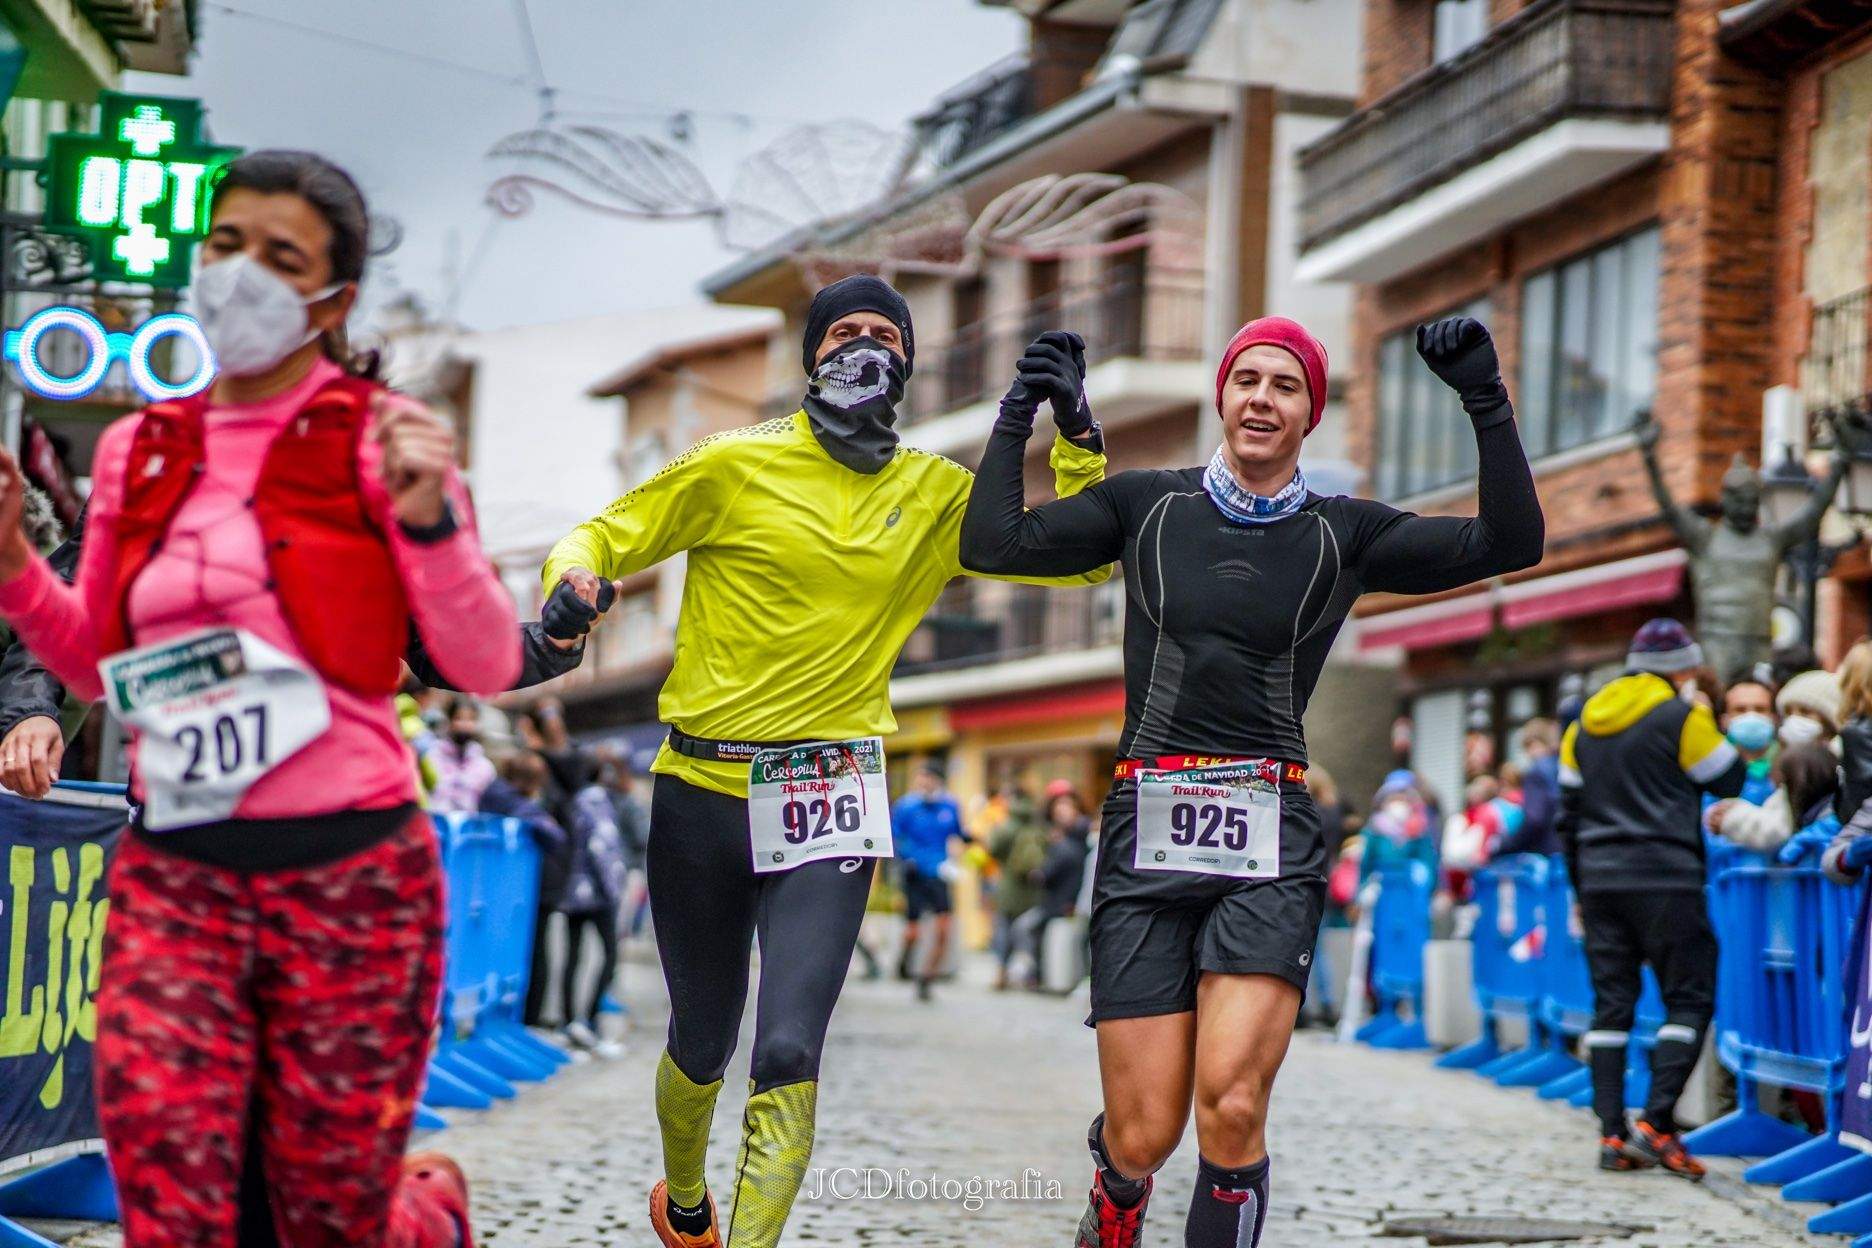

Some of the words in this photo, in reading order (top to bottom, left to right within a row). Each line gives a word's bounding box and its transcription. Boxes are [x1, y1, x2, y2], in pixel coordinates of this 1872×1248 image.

[76, 156, 213, 235] OPT
[174, 704, 266, 782] 207
[717, 742, 762, 754] triathlon
[854, 744, 873, 754] 2021
[1114, 764, 1128, 776] EKI
[1183, 757, 1231, 767] LEKI
[1287, 767, 1305, 780] LE
[1204, 769, 1248, 780] NAVIDAD
[780, 782, 807, 794] Trail
[808, 781, 836, 792] Run
[1171, 785, 1200, 796] Trail
[1200, 786, 1231, 798] Run
[782, 794, 861, 845] 926
[1170, 803, 1248, 851] 925
